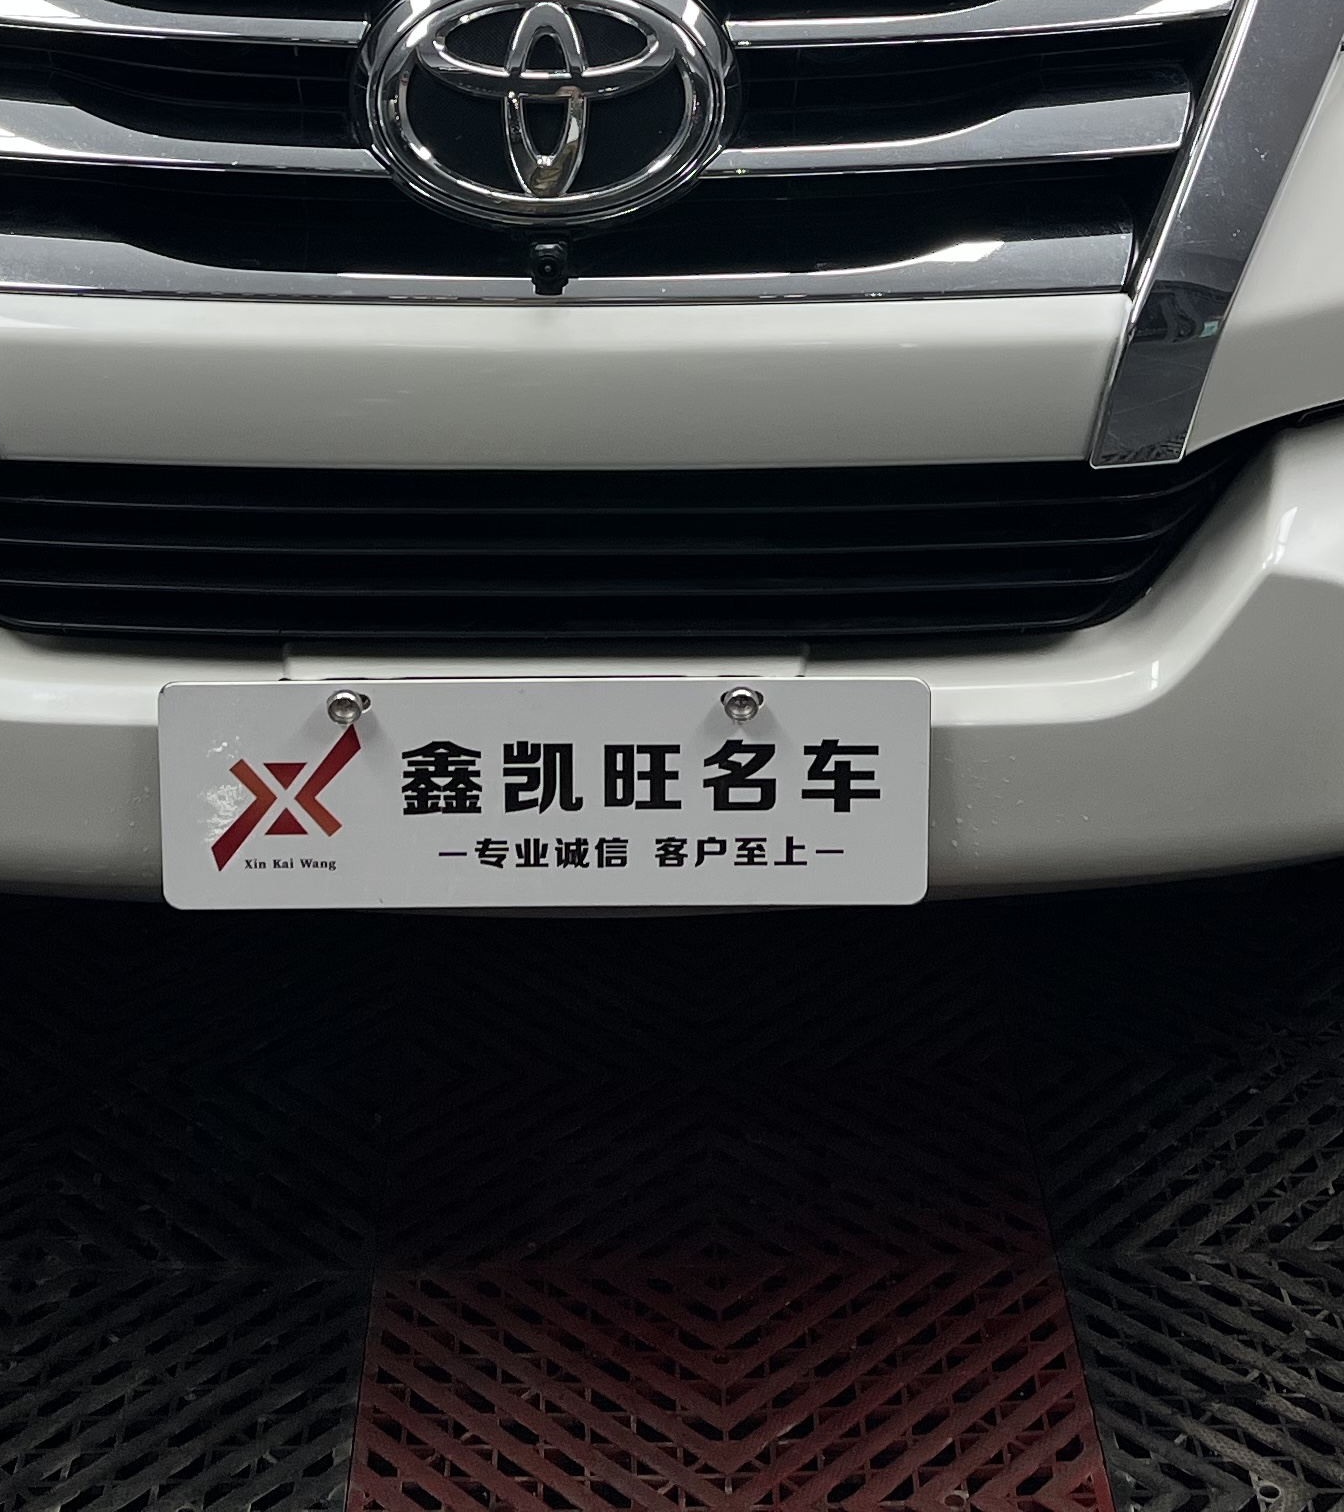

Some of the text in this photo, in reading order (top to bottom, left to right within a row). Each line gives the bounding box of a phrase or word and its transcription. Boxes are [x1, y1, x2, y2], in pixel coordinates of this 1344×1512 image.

[401, 739, 881, 815] 鑫凯旺名车
[244, 857, 337, 871] Xin Kai Wang
